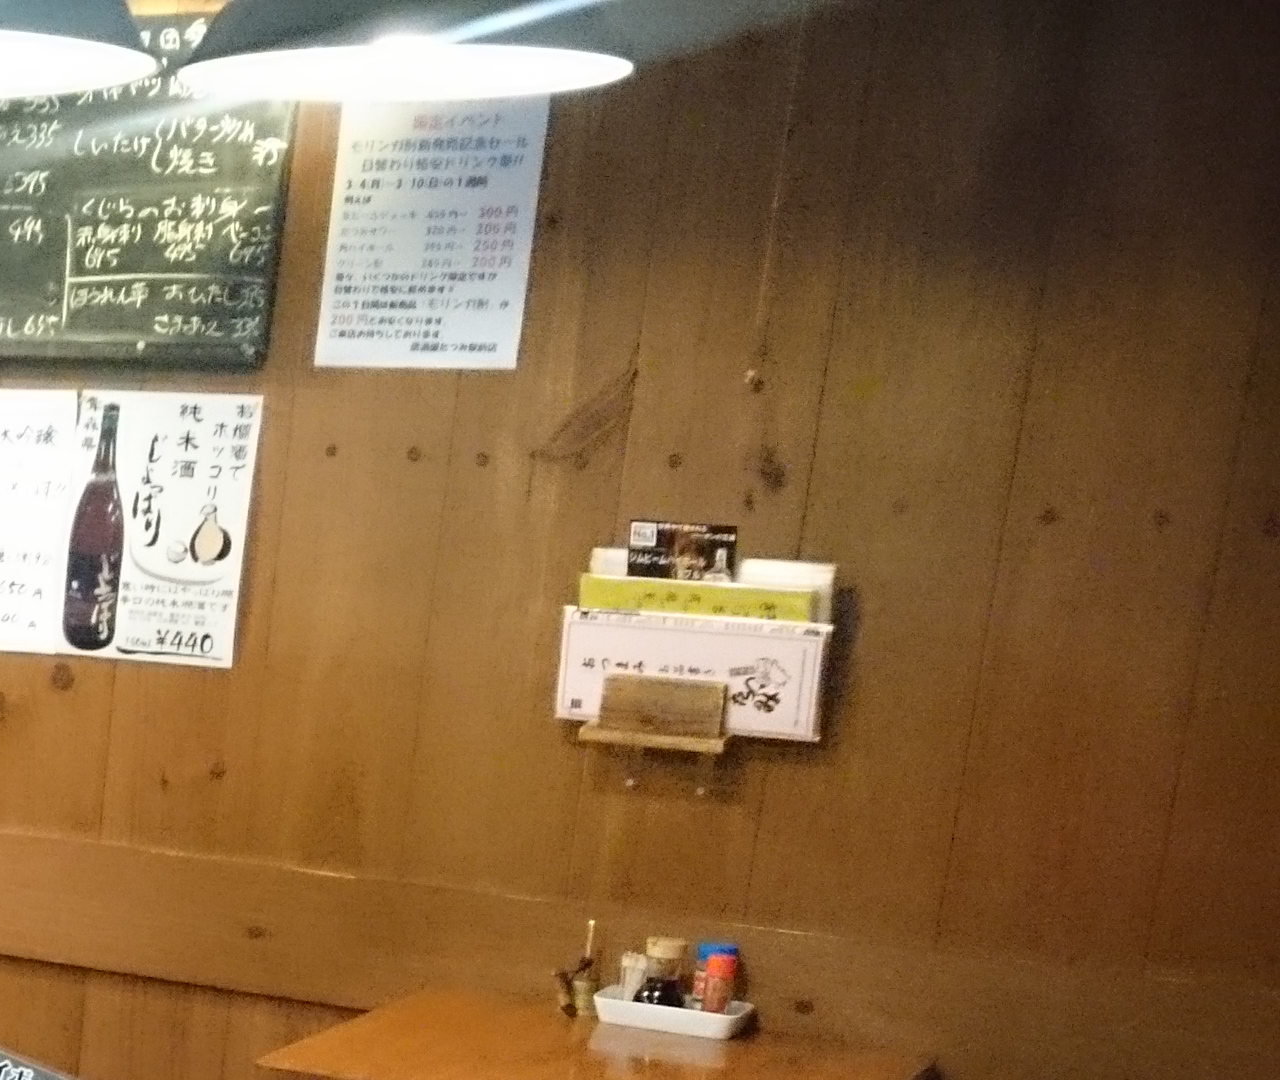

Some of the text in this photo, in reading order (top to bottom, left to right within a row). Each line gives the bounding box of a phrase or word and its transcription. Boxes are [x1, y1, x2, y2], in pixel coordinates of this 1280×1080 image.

[74, 128, 152, 157] しいたけ
[164, 144, 219, 175] 焼き
[69, 282, 149, 310] ほうれん草
[162, 282, 240, 307] おひたし
[172, 403, 204, 479] 純米酒
[207, 422, 228, 500] ホッコリ
[132, 433, 169, 548] じょっぱり
[155, 628, 215, 655] ¥440
